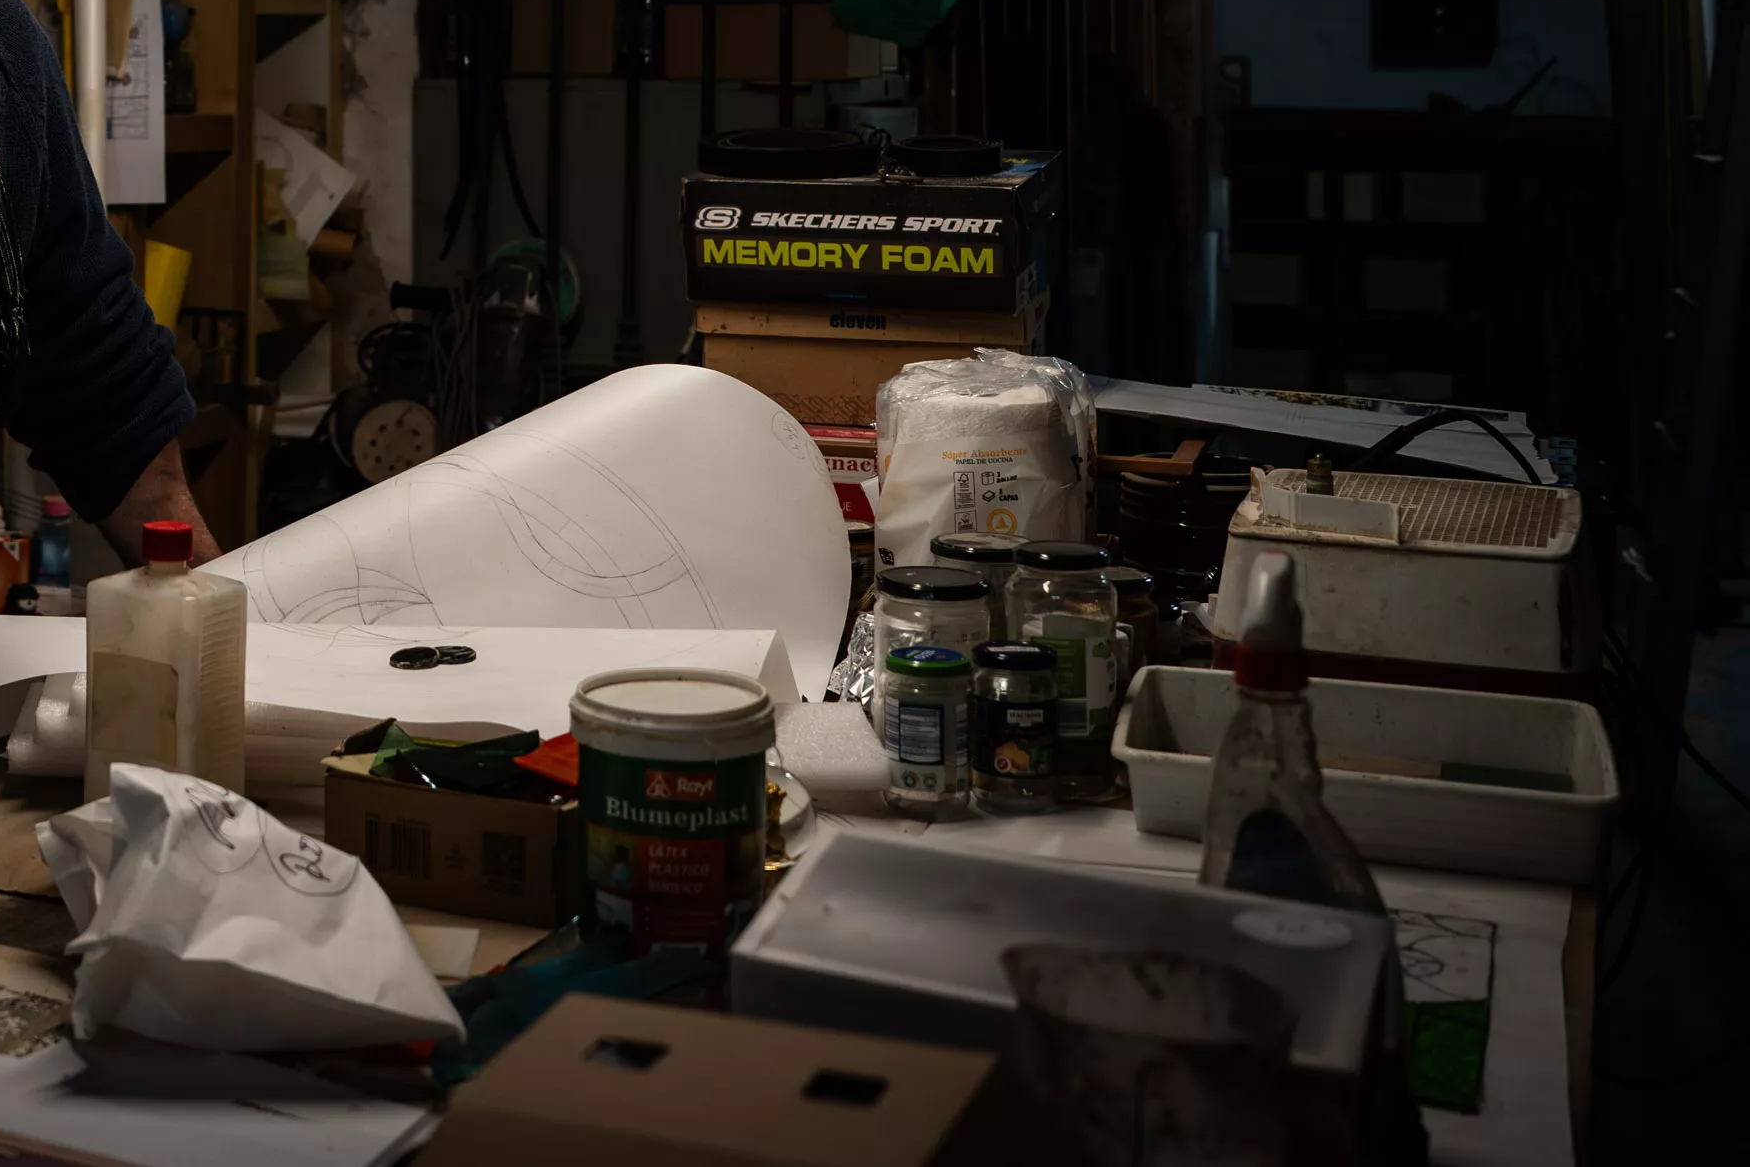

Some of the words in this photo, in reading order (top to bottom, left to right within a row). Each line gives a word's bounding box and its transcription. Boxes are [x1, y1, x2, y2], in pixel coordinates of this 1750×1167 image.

[750, 212, 898, 231] SKECHERS
[902, 216, 1003, 234] SPORT
[702, 237, 870, 270] MEMORY
[881, 244, 995, 275] FOAM
[829, 311, 887, 330] eleven
[999, 494, 1019, 502] CAPAS
[605, 796, 750, 832] Blumeplast
